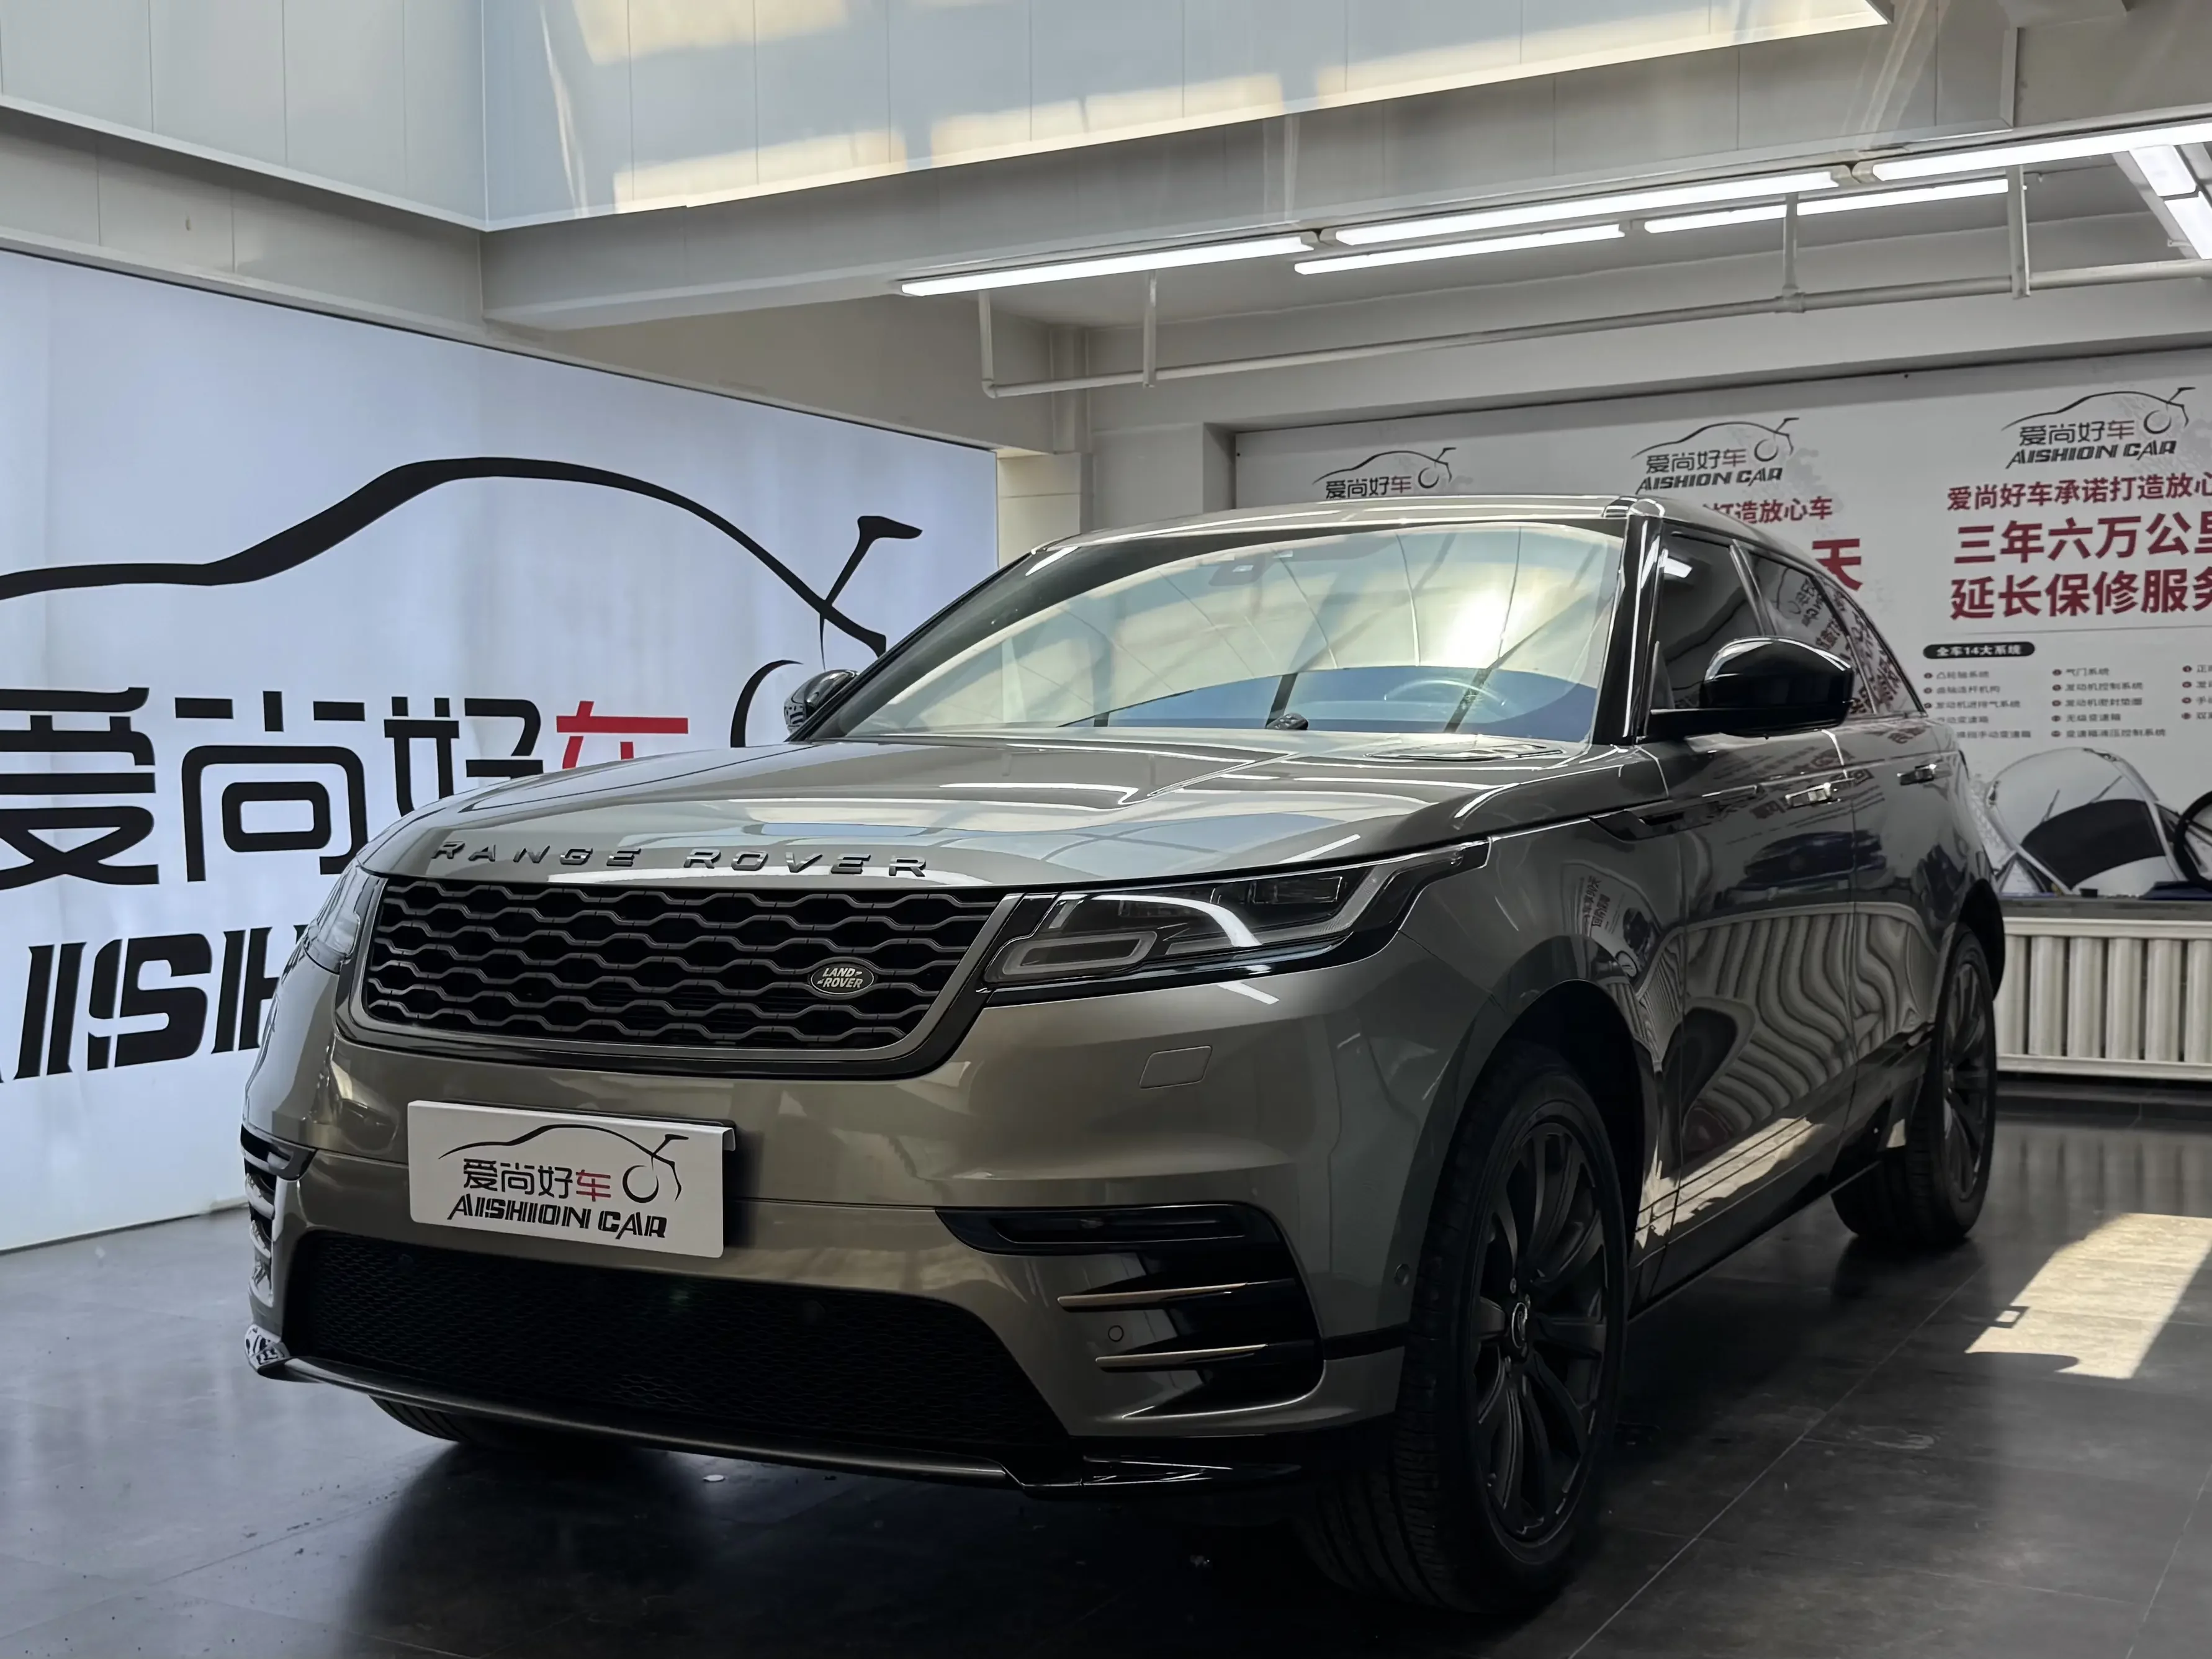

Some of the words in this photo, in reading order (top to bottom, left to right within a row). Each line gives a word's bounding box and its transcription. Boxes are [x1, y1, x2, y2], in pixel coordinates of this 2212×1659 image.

[2018, 420, 2135, 446] 爱尚好车
[1646, 449, 1747, 474] 爱尚好车
[2005, 444, 2118, 469] AISHION
[2123, 440, 2177, 461] CAR
[1325, 475, 1412, 499] 爱尚好车
[1635, 471, 1732, 495] AISHION
[1737, 468, 1783, 487] CAR
[1702, 496, 1833, 524] 造放心车
[429, 839, 642, 868] RANGE
[682, 847, 928, 878] ROVER
[463, 1158, 612, 1203] 爱尚好车
[447, 1193, 592, 1230] AISHION
[597, 1210, 668, 1240] CAR
